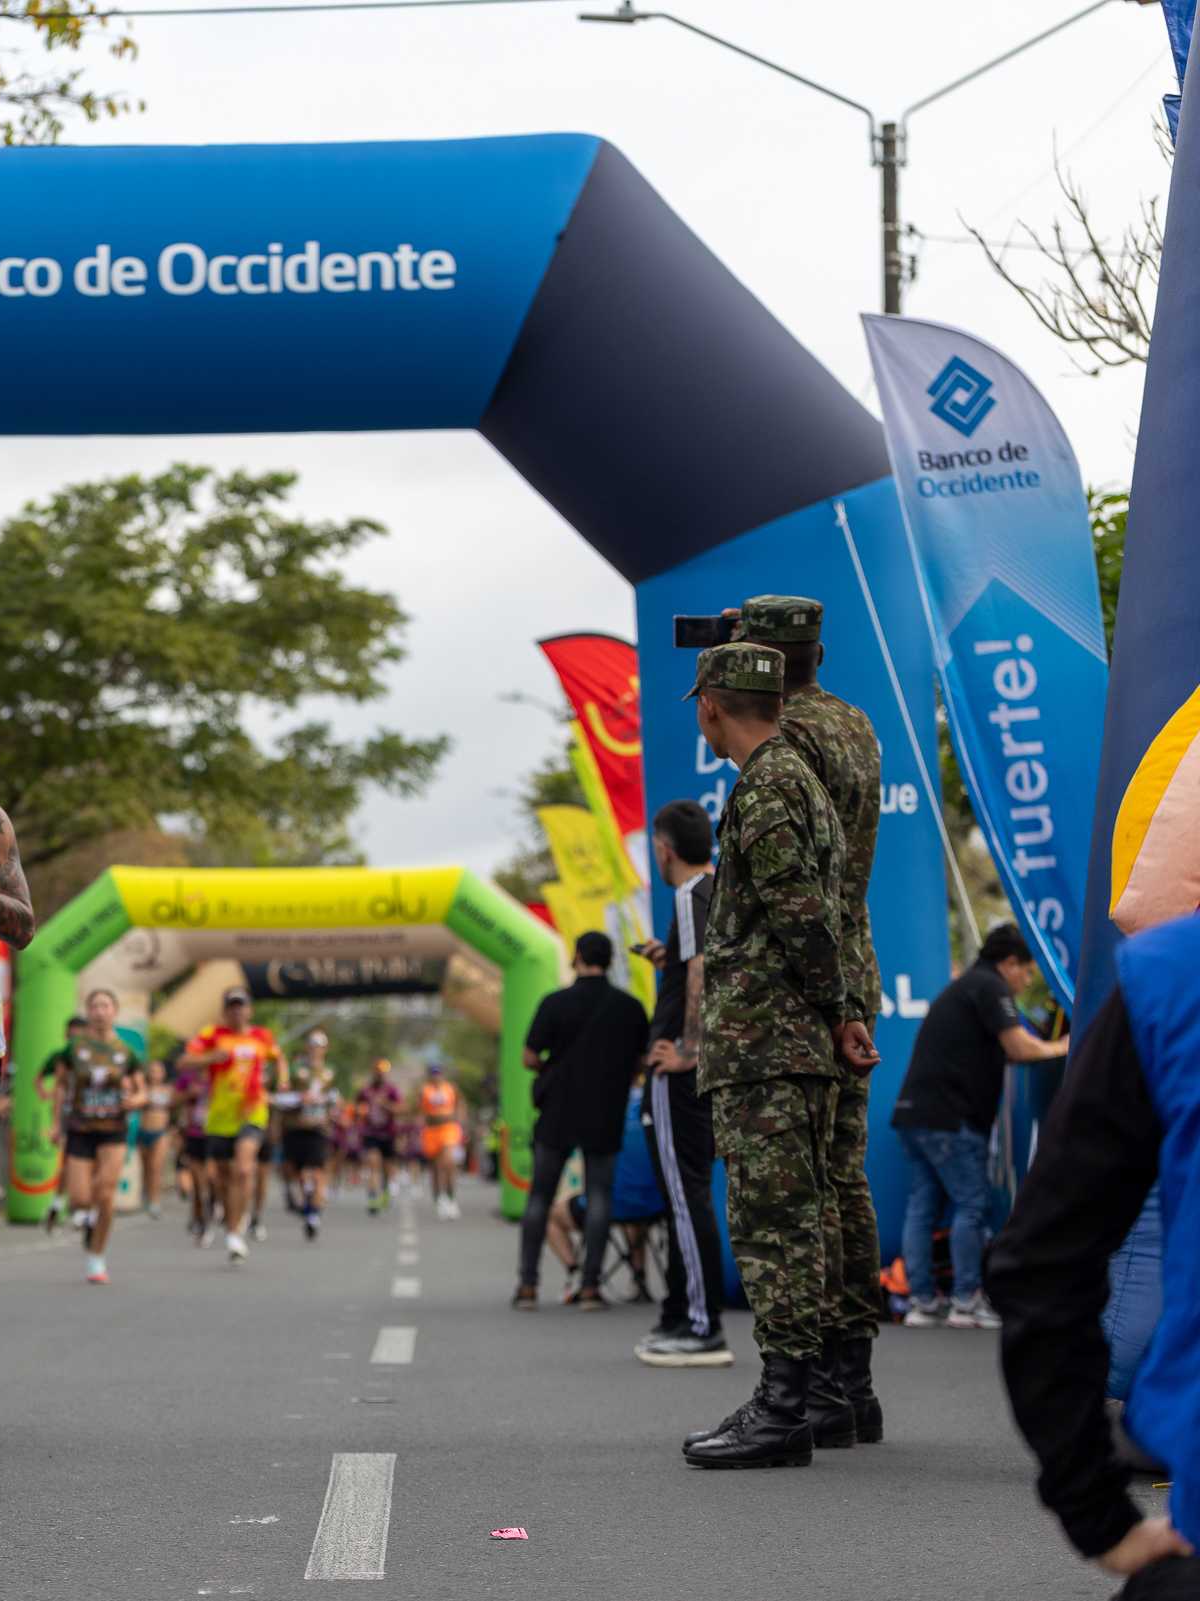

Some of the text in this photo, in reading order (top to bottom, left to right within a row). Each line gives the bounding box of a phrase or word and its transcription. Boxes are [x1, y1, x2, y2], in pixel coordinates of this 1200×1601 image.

[73, 244, 148, 297] de
[158, 240, 457, 295] Occidente
[918, 440, 1029, 472] Banco de
[916, 467, 1041, 499] Occidente
